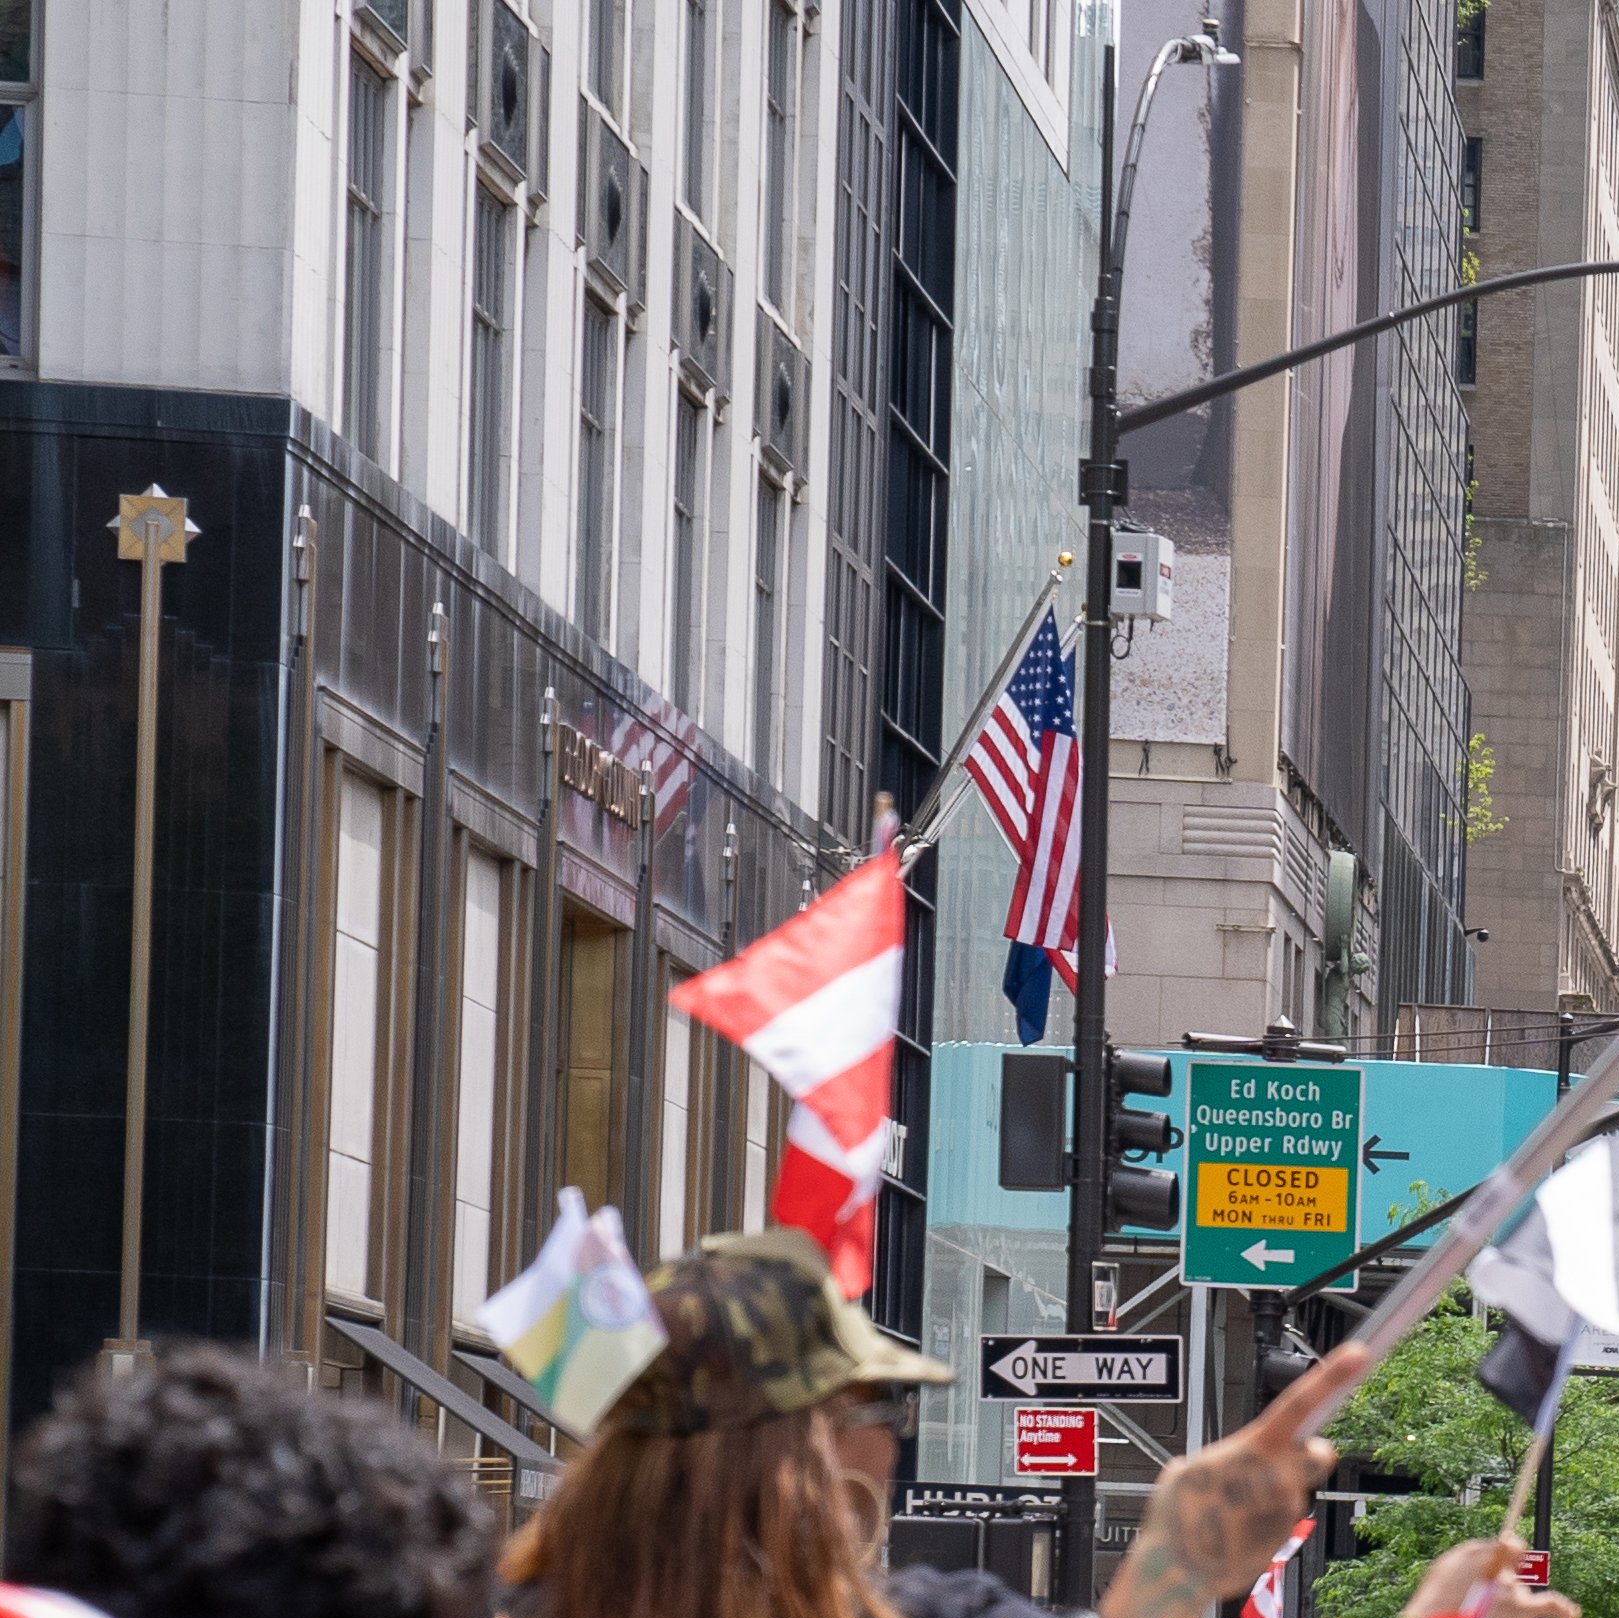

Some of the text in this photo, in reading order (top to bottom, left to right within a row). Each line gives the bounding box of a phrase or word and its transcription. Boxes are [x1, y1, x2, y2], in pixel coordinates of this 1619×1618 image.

[1230, 1079, 1321, 1103] Ed Koch
[1196, 1105, 1354, 1130] Queensboro Br
[1205, 1133, 1273, 1157] Upper
[1282, 1135, 1343, 1162] Rdwy
[1227, 1168, 1320, 1189] CLOSED
[1228, 1191, 1260, 1205] 6AM
[1276, 1193, 1317, 1207] 10AM
[1212, 1209, 1331, 1227] MON THRU FRI
[1012, 1357, 1154, 1381] ONE WAY
[1020, 1414, 1085, 1429] NO STANDING
[1021, 1429, 1062, 1445] Anytime
[905, 1488, 1062, 1518] HUBL
